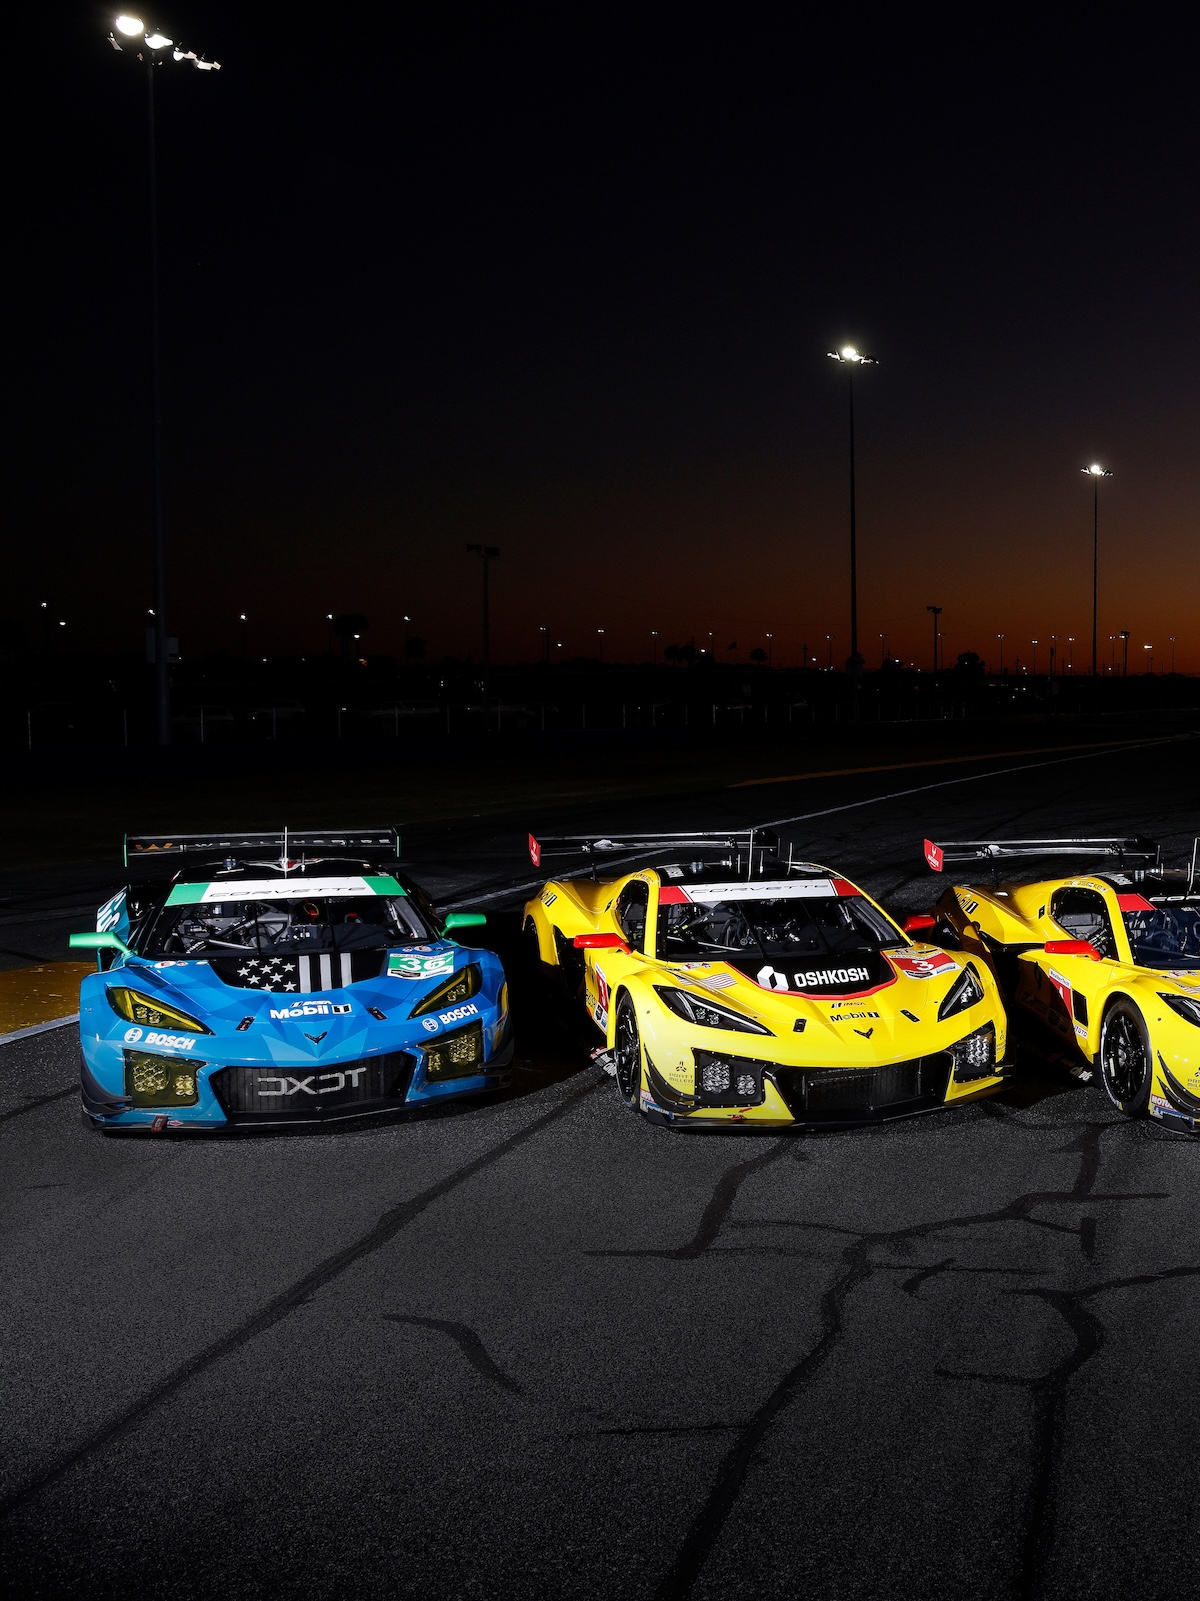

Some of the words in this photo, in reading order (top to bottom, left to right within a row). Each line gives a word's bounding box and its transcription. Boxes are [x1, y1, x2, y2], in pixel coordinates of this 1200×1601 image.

[209, 886, 366, 897] CORVETTE
[690, 884, 829, 894] CORVETTE
[399, 956, 447, 972] 36
[911, 959, 935, 971] 3
[793, 967, 870, 988] OSHKOSH
[270, 1004, 329, 1020] Mobil
[438, 1003, 479, 1025] BOSCH
[829, 1011, 867, 1022] Mobil
[144, 1032, 197, 1050] BOSCH
